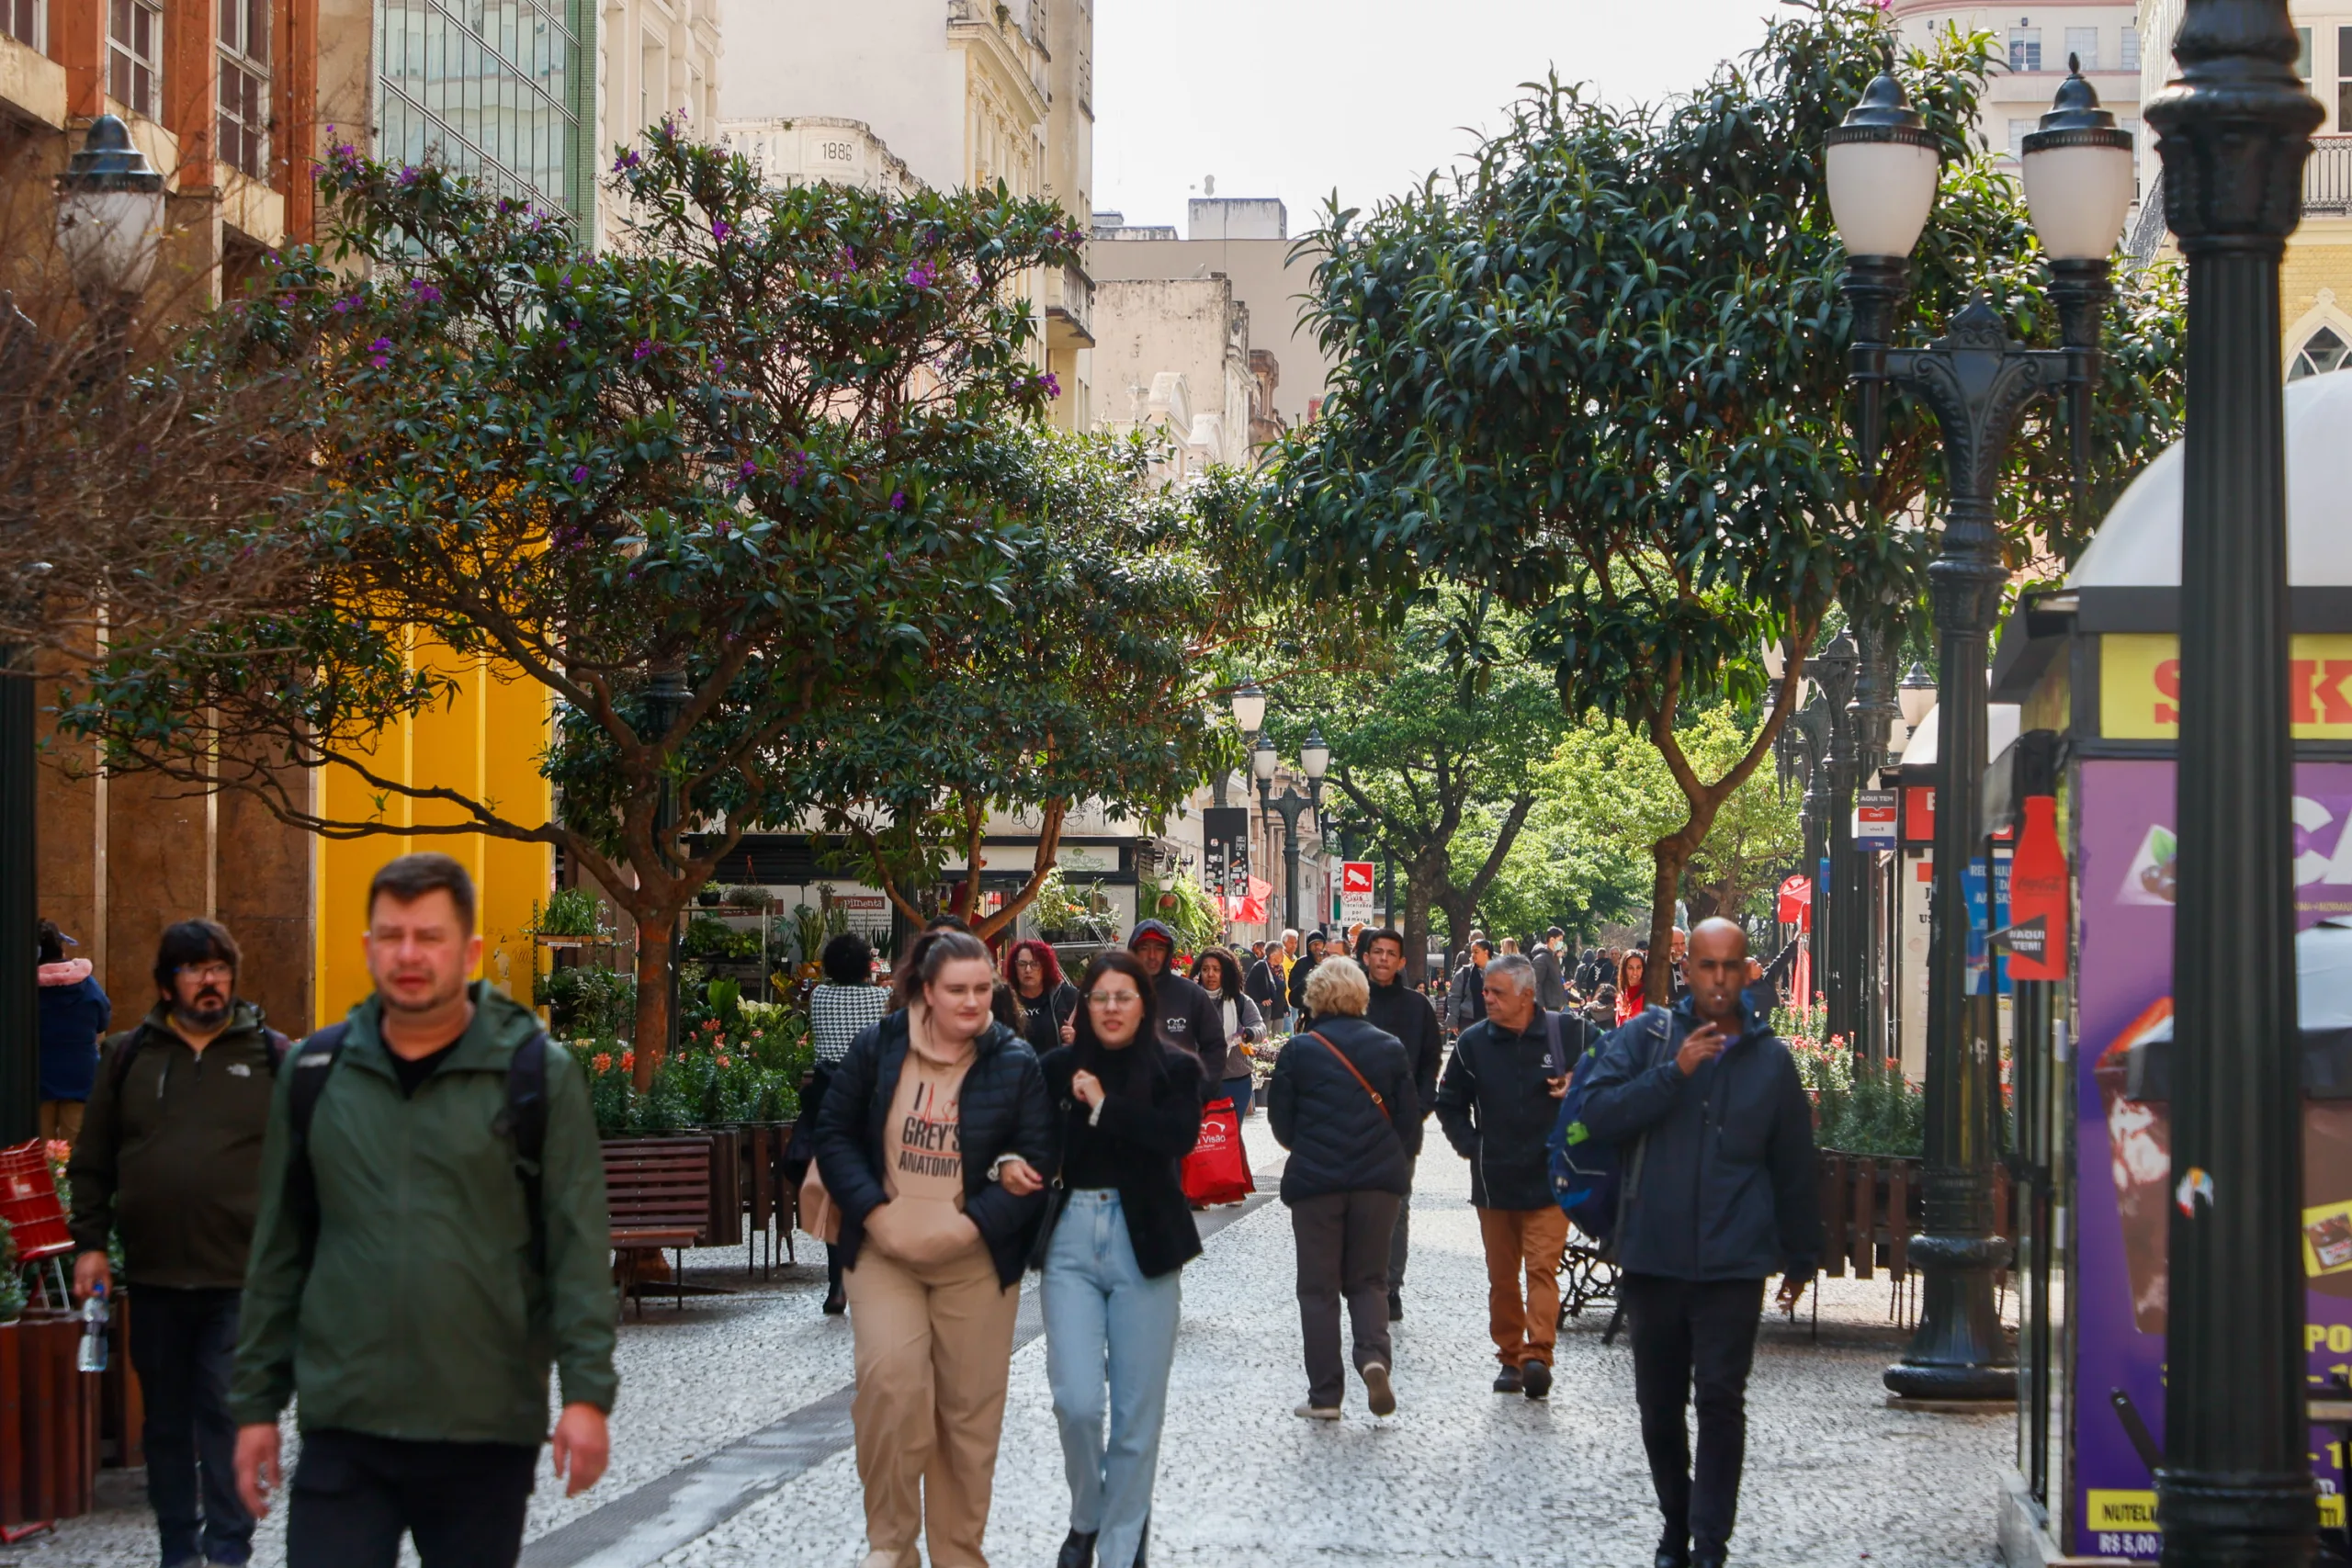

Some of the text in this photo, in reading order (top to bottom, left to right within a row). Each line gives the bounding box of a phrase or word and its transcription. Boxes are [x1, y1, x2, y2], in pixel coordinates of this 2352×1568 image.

[822, 142, 853, 161] 1886
[843, 898, 882, 908] pimenta
[2008, 931, 2045, 940] #AQUI
[2012, 941, 2041, 951] TEM!
[914, 1081, 924, 1111] I
[902, 1116, 960, 1152] GREY'S
[899, 1149, 961, 1178] ANATOMY
[2098, 1532, 2157, 1557] R$ 5,00
